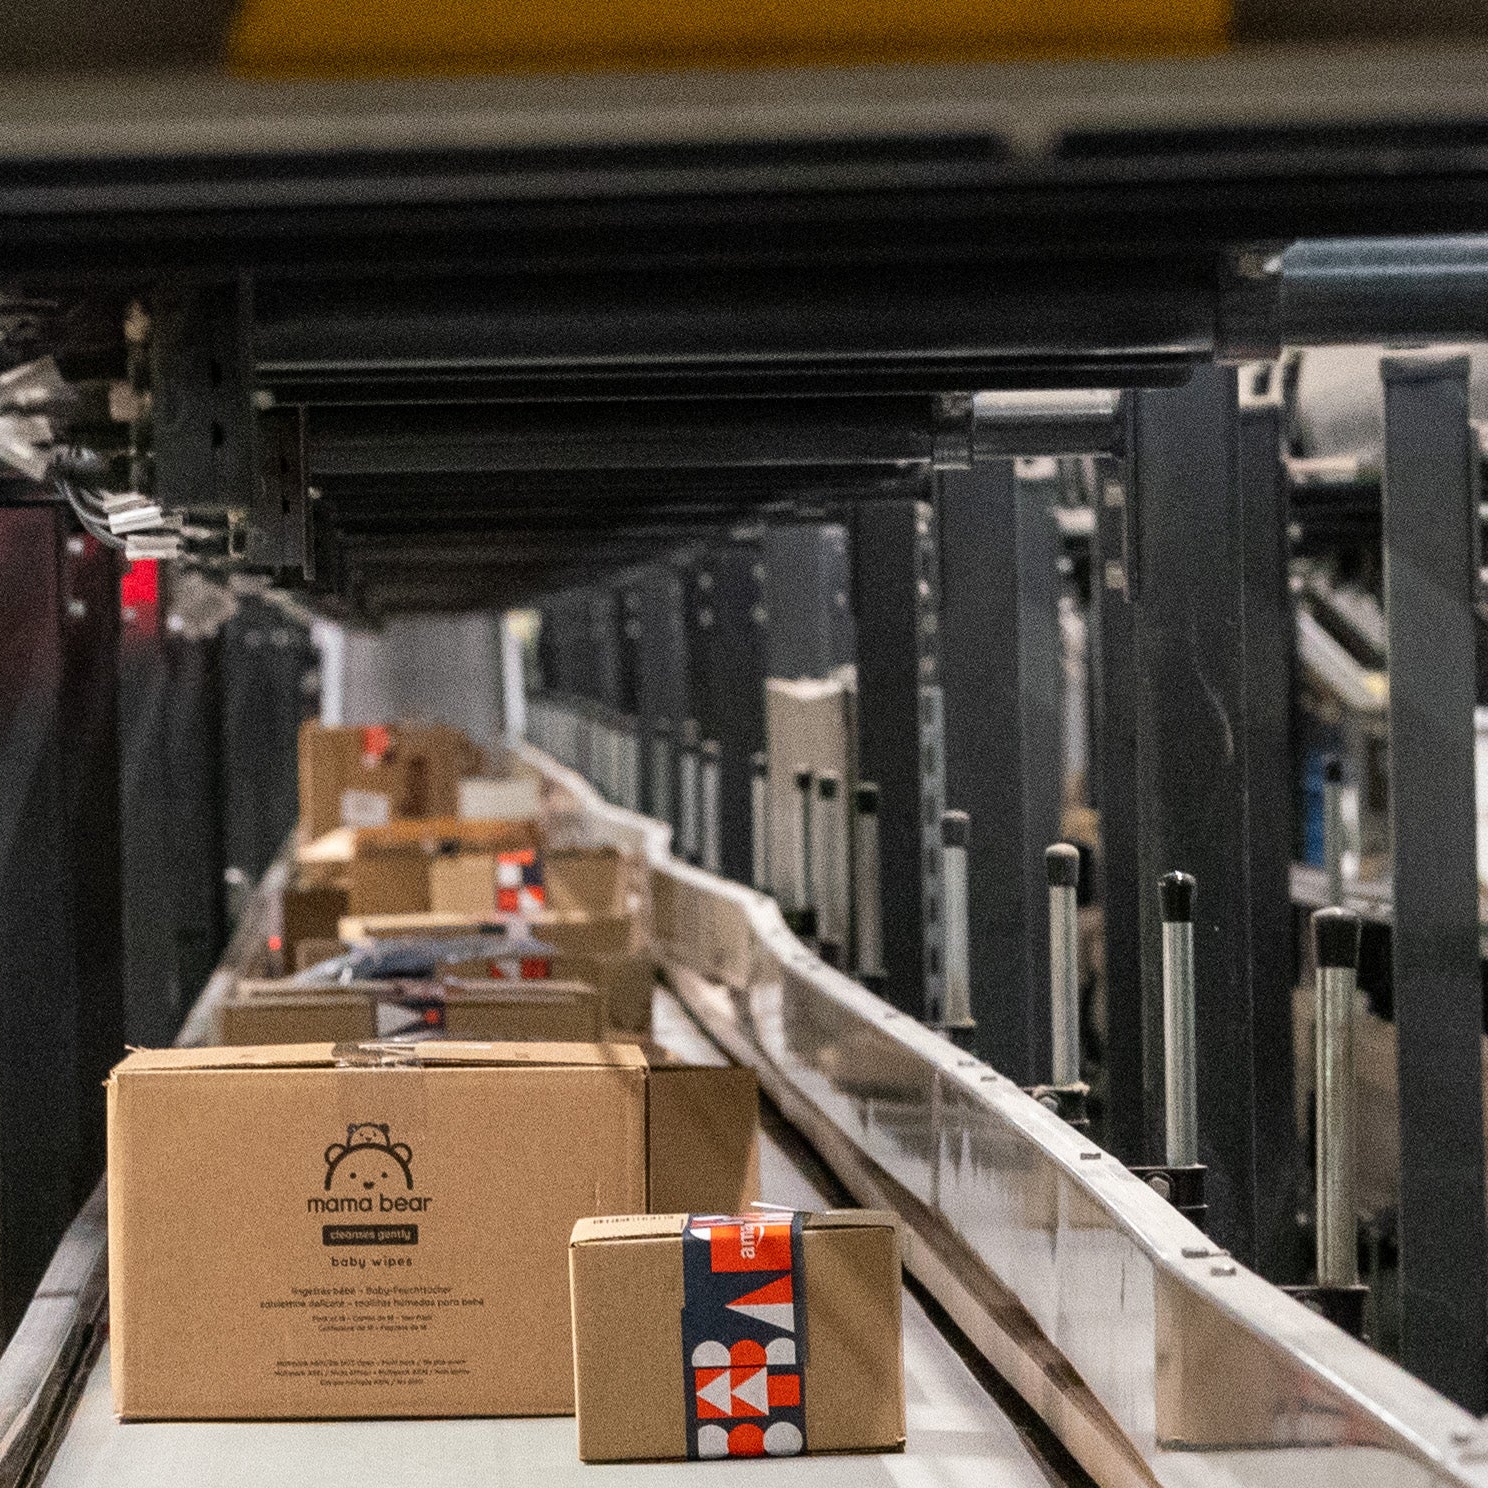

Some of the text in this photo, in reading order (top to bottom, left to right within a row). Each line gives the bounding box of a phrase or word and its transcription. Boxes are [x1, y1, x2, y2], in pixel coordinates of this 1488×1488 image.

[307, 1193, 432, 1213] mama bear
[330, 1228, 411, 1241] cleanses gently
[331, 1256, 412, 1269] baby wipes
